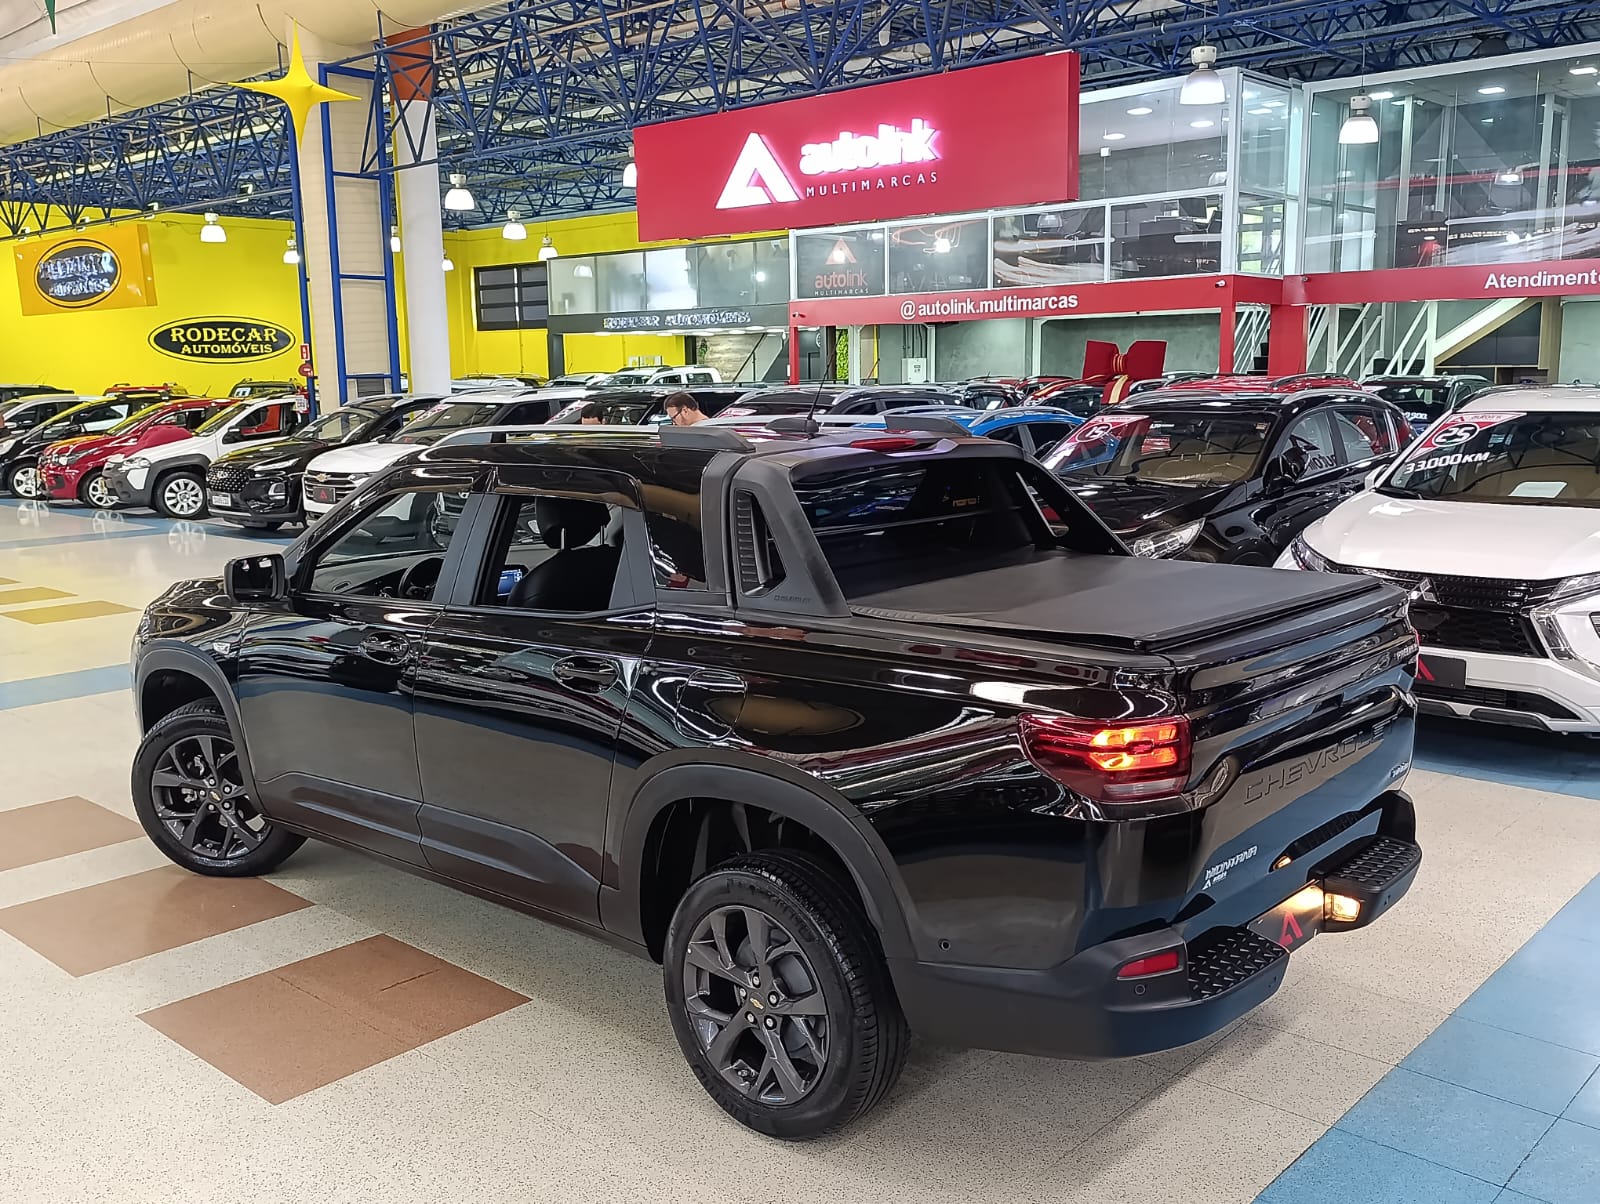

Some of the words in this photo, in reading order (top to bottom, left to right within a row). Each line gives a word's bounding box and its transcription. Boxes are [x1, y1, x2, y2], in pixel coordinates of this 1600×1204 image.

[799, 118, 938, 175] autolink
[806, 172, 937, 197] MULTIMARCAS
[815, 269, 868, 289] autolink
[815, 288, 869, 296] MULTIMARCAS
[170, 327, 278, 343] RODECAR
[181, 342, 273, 354] AUTOMÓVEIS
[1434, 427, 1475, 443] 25
[1244, 714, 1399, 805] CHEVROLET
[1205, 845, 1258, 880] MONTANA
